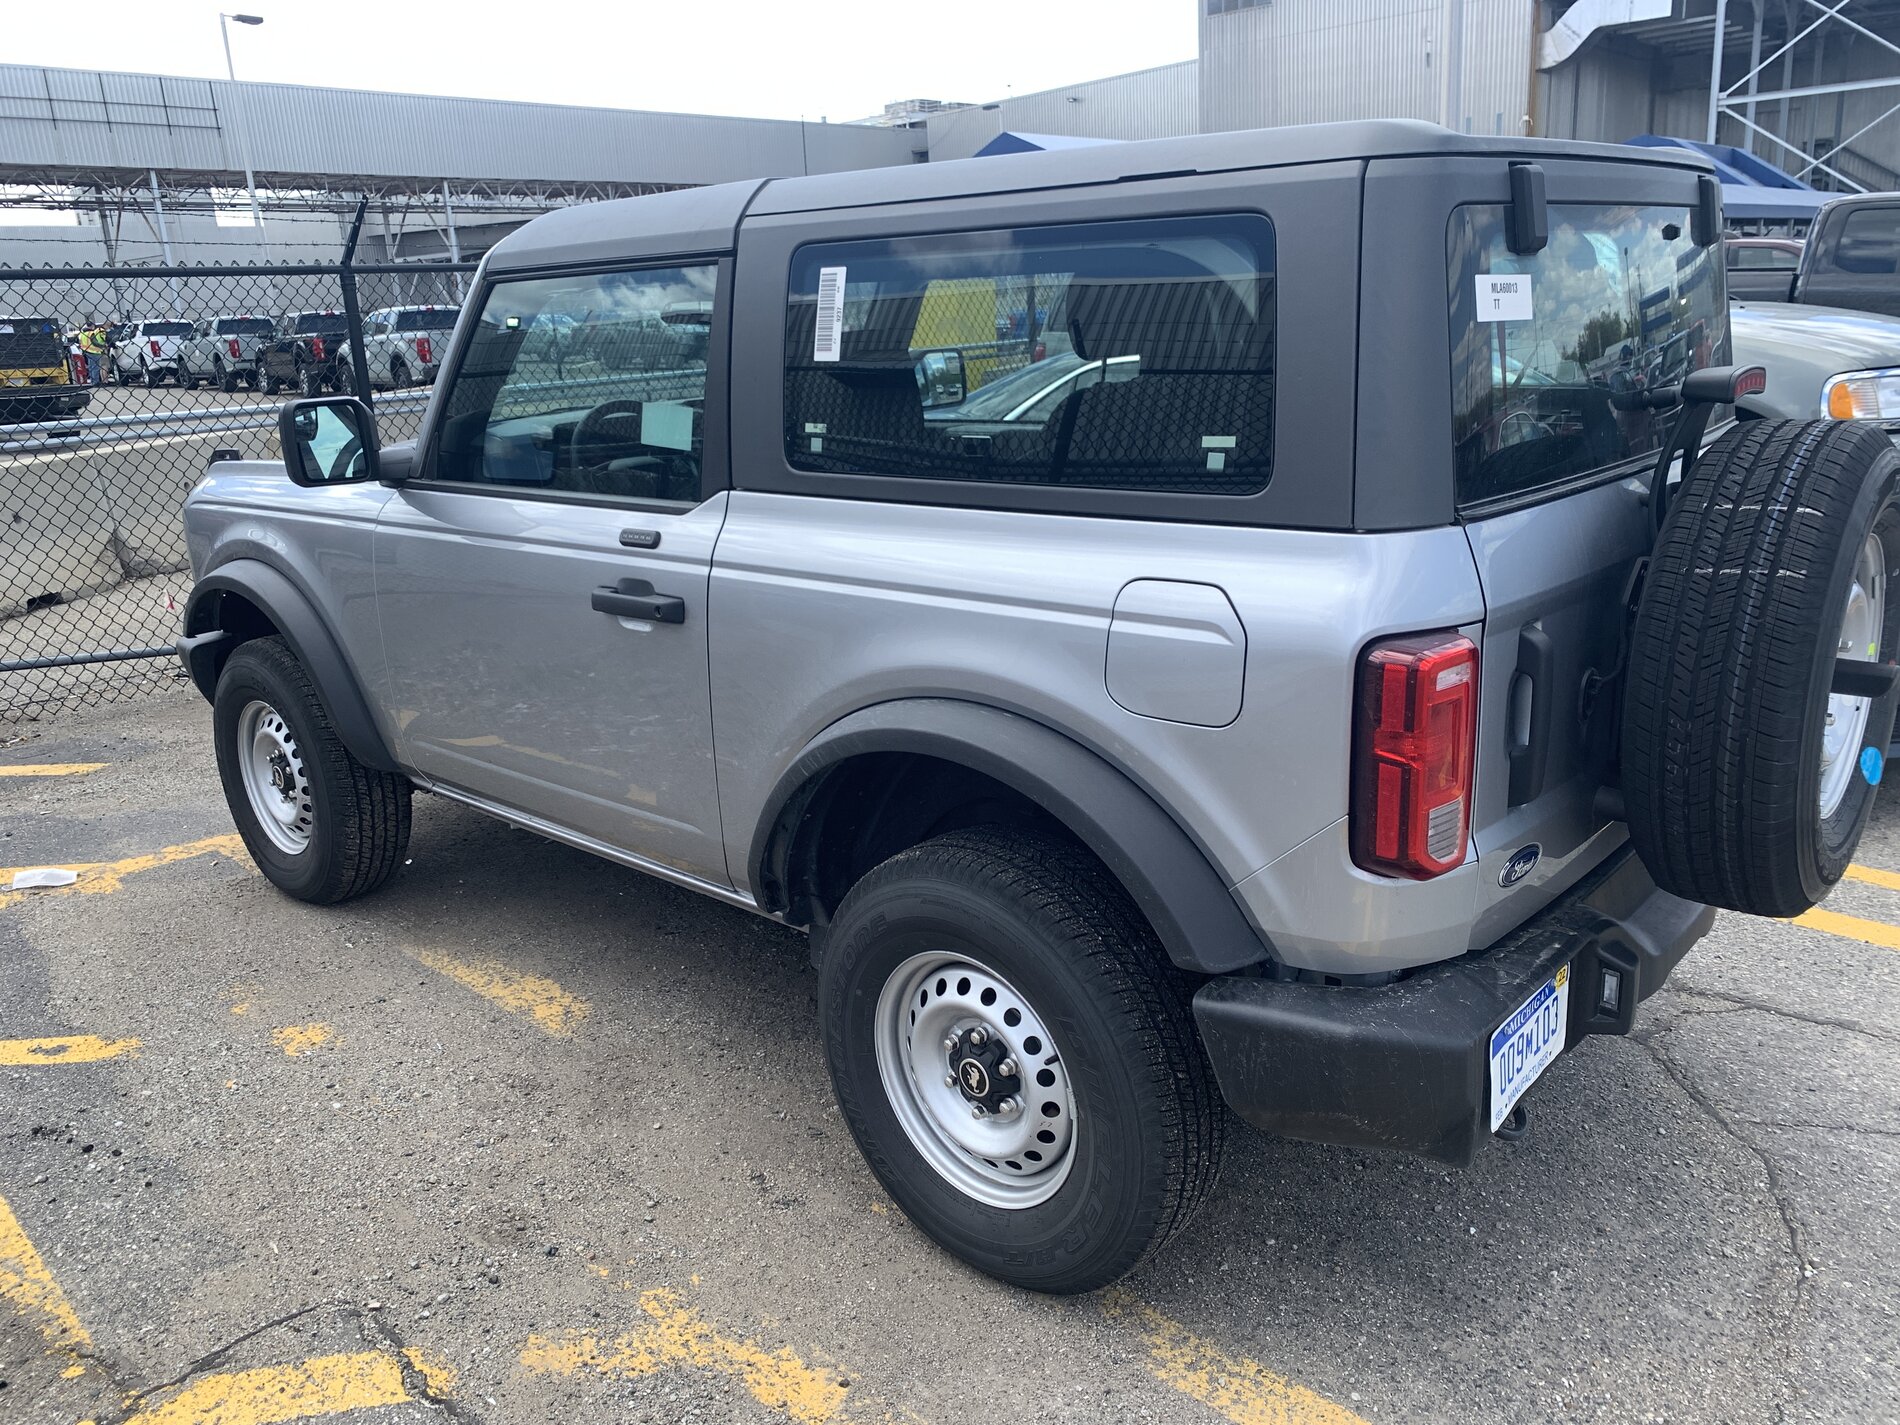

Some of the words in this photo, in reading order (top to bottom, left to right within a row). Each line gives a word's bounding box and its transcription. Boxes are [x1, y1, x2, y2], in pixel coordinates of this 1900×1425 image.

[1491, 282, 1518, 294] MLA60013
[1557, 970, 1566, 983] 22
[1508, 987, 1550, 1034] MICHIGAN
[1499, 995, 1559, 1096] 009M103
[1507, 1052, 1549, 1105] MANUFACTURER
